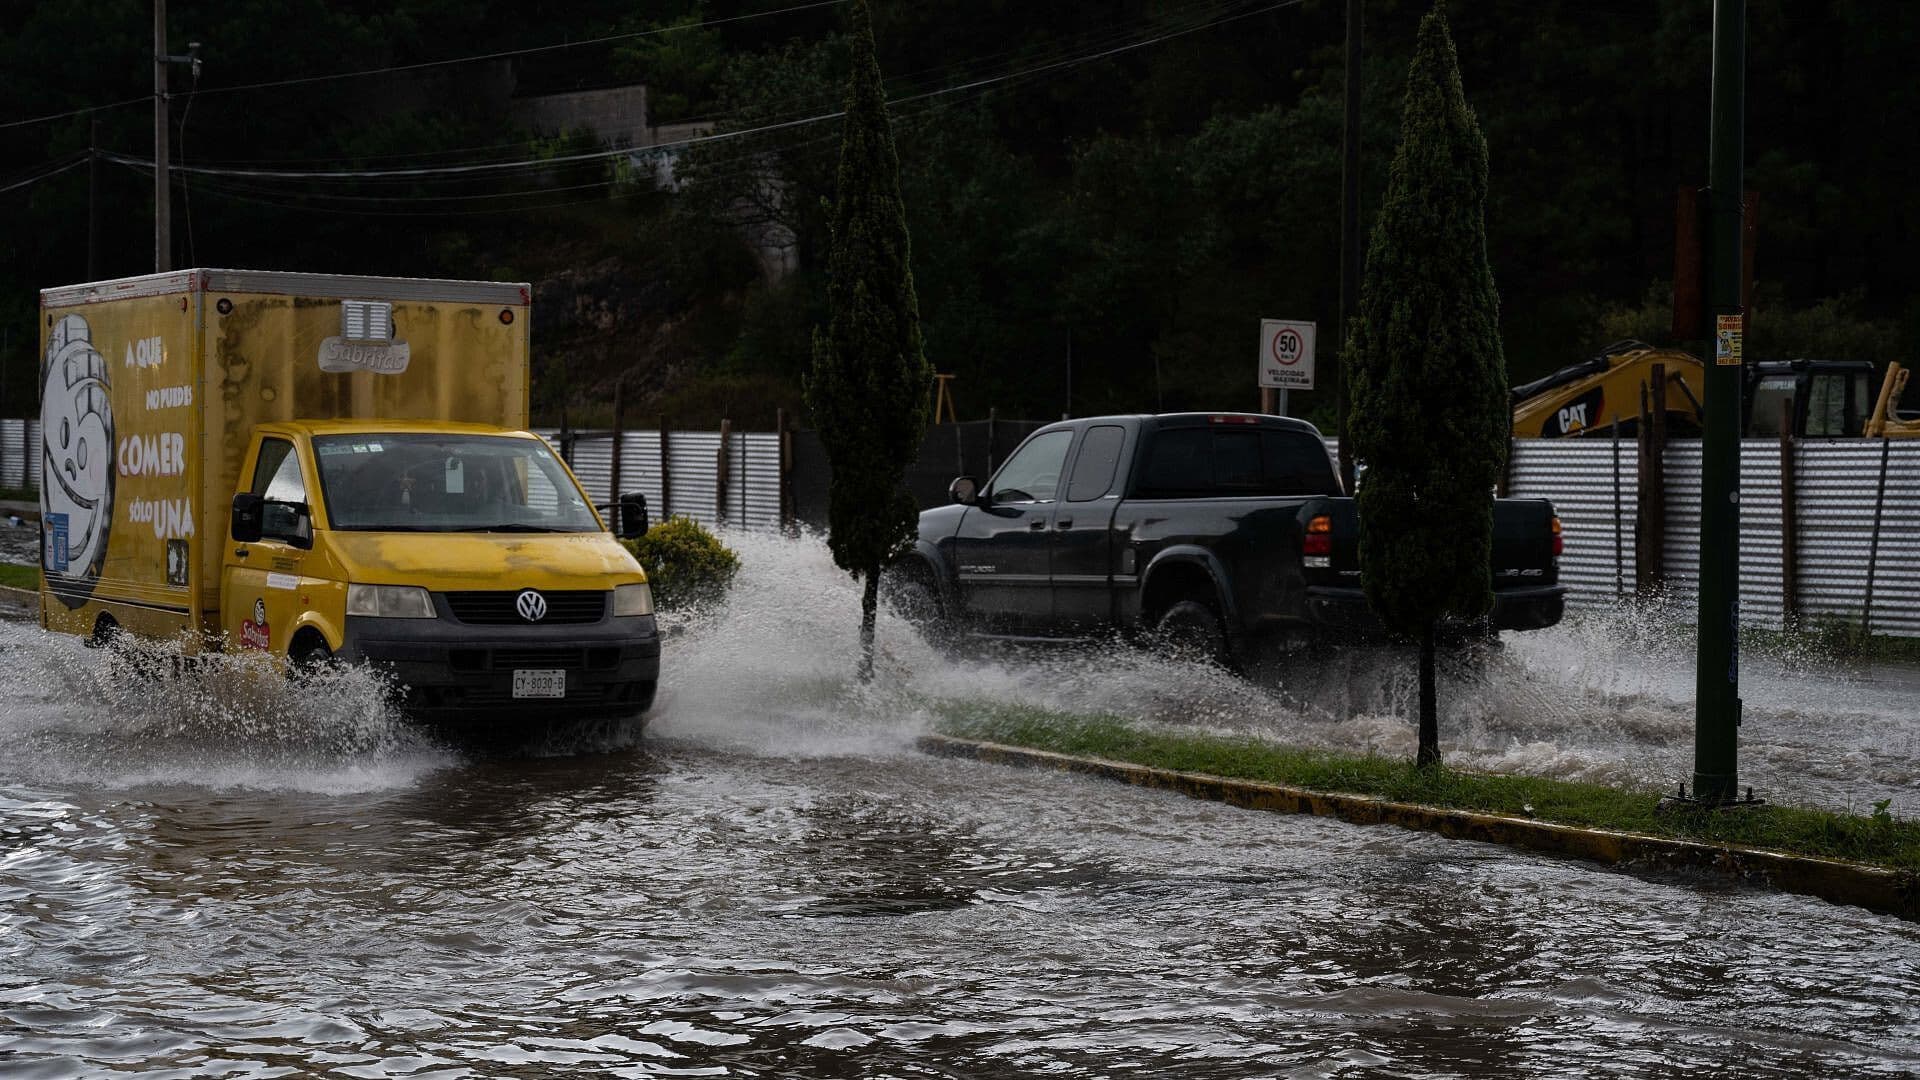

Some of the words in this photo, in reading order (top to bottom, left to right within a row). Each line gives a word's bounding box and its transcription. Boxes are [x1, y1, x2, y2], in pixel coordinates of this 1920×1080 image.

[125, 340, 135, 369] A
[136, 335, 162, 369] QUE
[327, 343, 405, 369] Sabritas
[1279, 335, 1297, 353] 50
[1267, 369, 1305, 377] VELOCIDAD
[145, 389, 160, 411] NO
[160, 384, 193, 409] PUEDES
[1558, 403, 1587, 434] CAT
[118, 432, 185, 477] COMER
[153, 496, 195, 539] UNA
[243, 621, 269, 649] Sabritas
